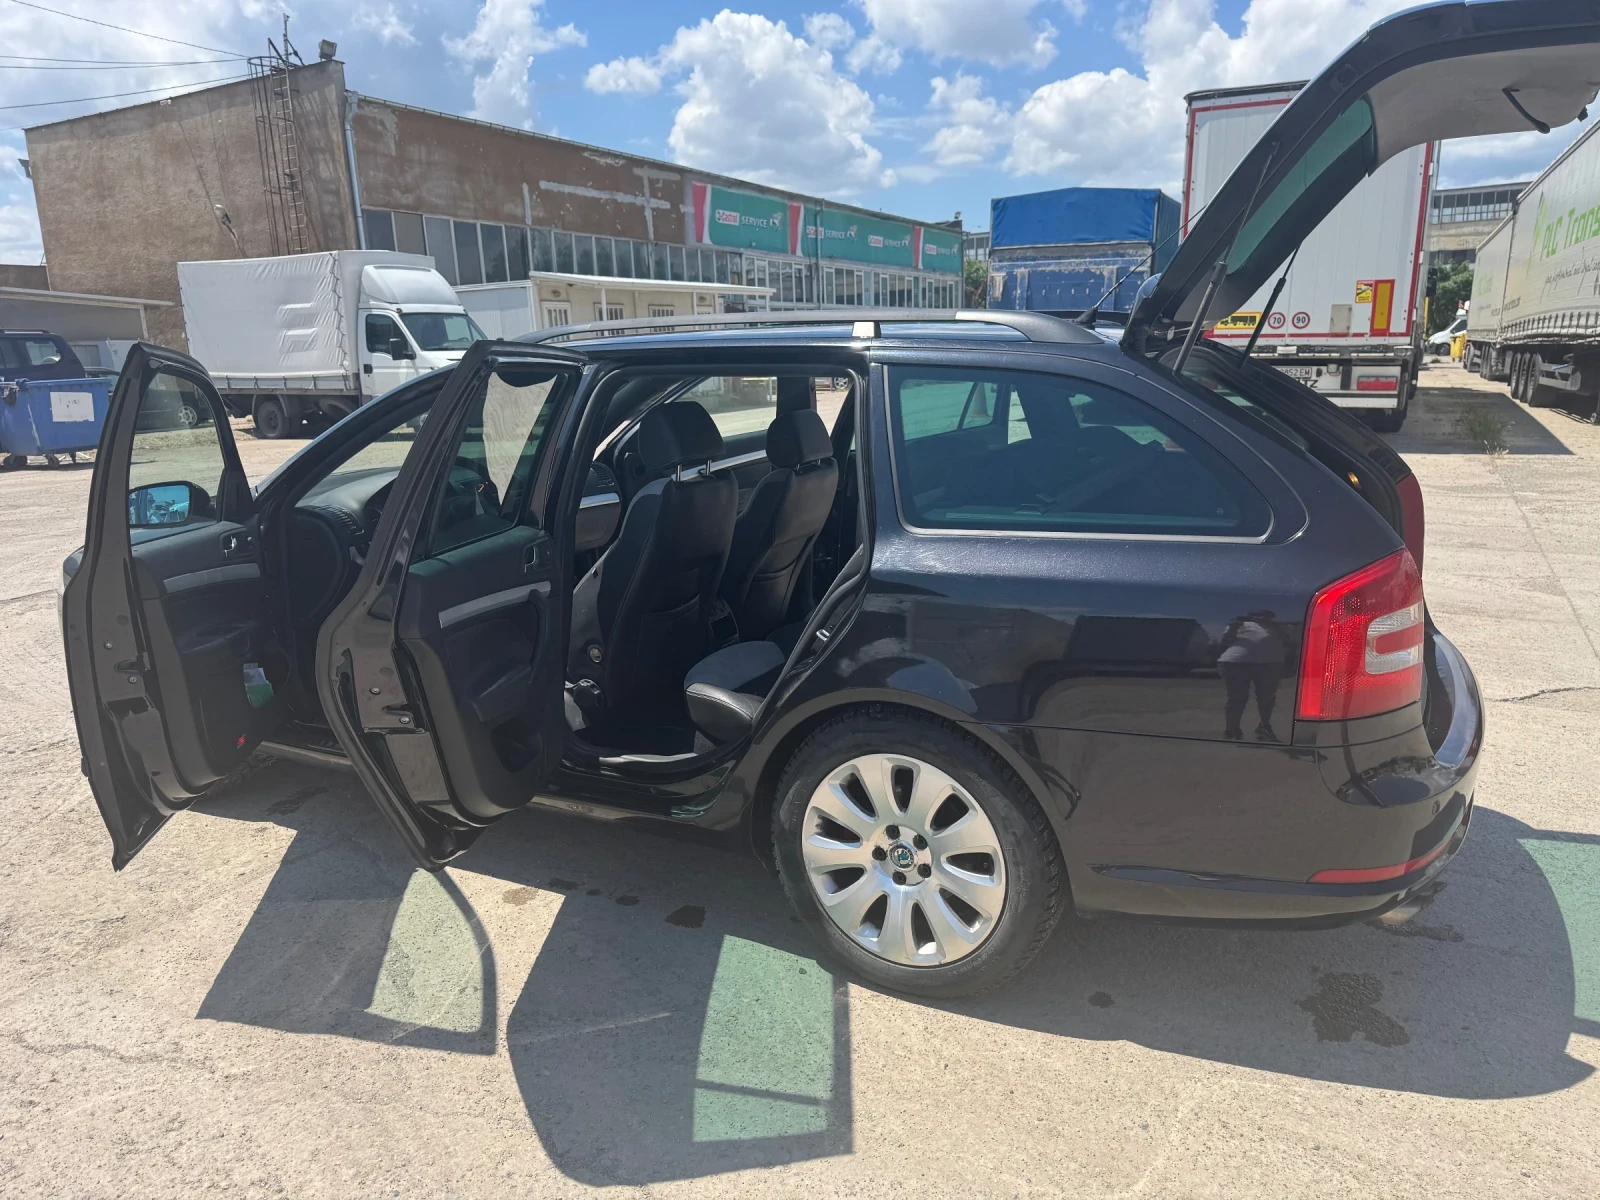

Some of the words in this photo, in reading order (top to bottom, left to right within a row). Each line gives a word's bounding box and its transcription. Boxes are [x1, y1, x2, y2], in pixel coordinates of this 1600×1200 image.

[718, 210, 739, 225] Castrol
[742, 216, 768, 228] SERVICE
[1272, 317, 1282, 325] 70
[1296, 316, 1306, 324] 90
